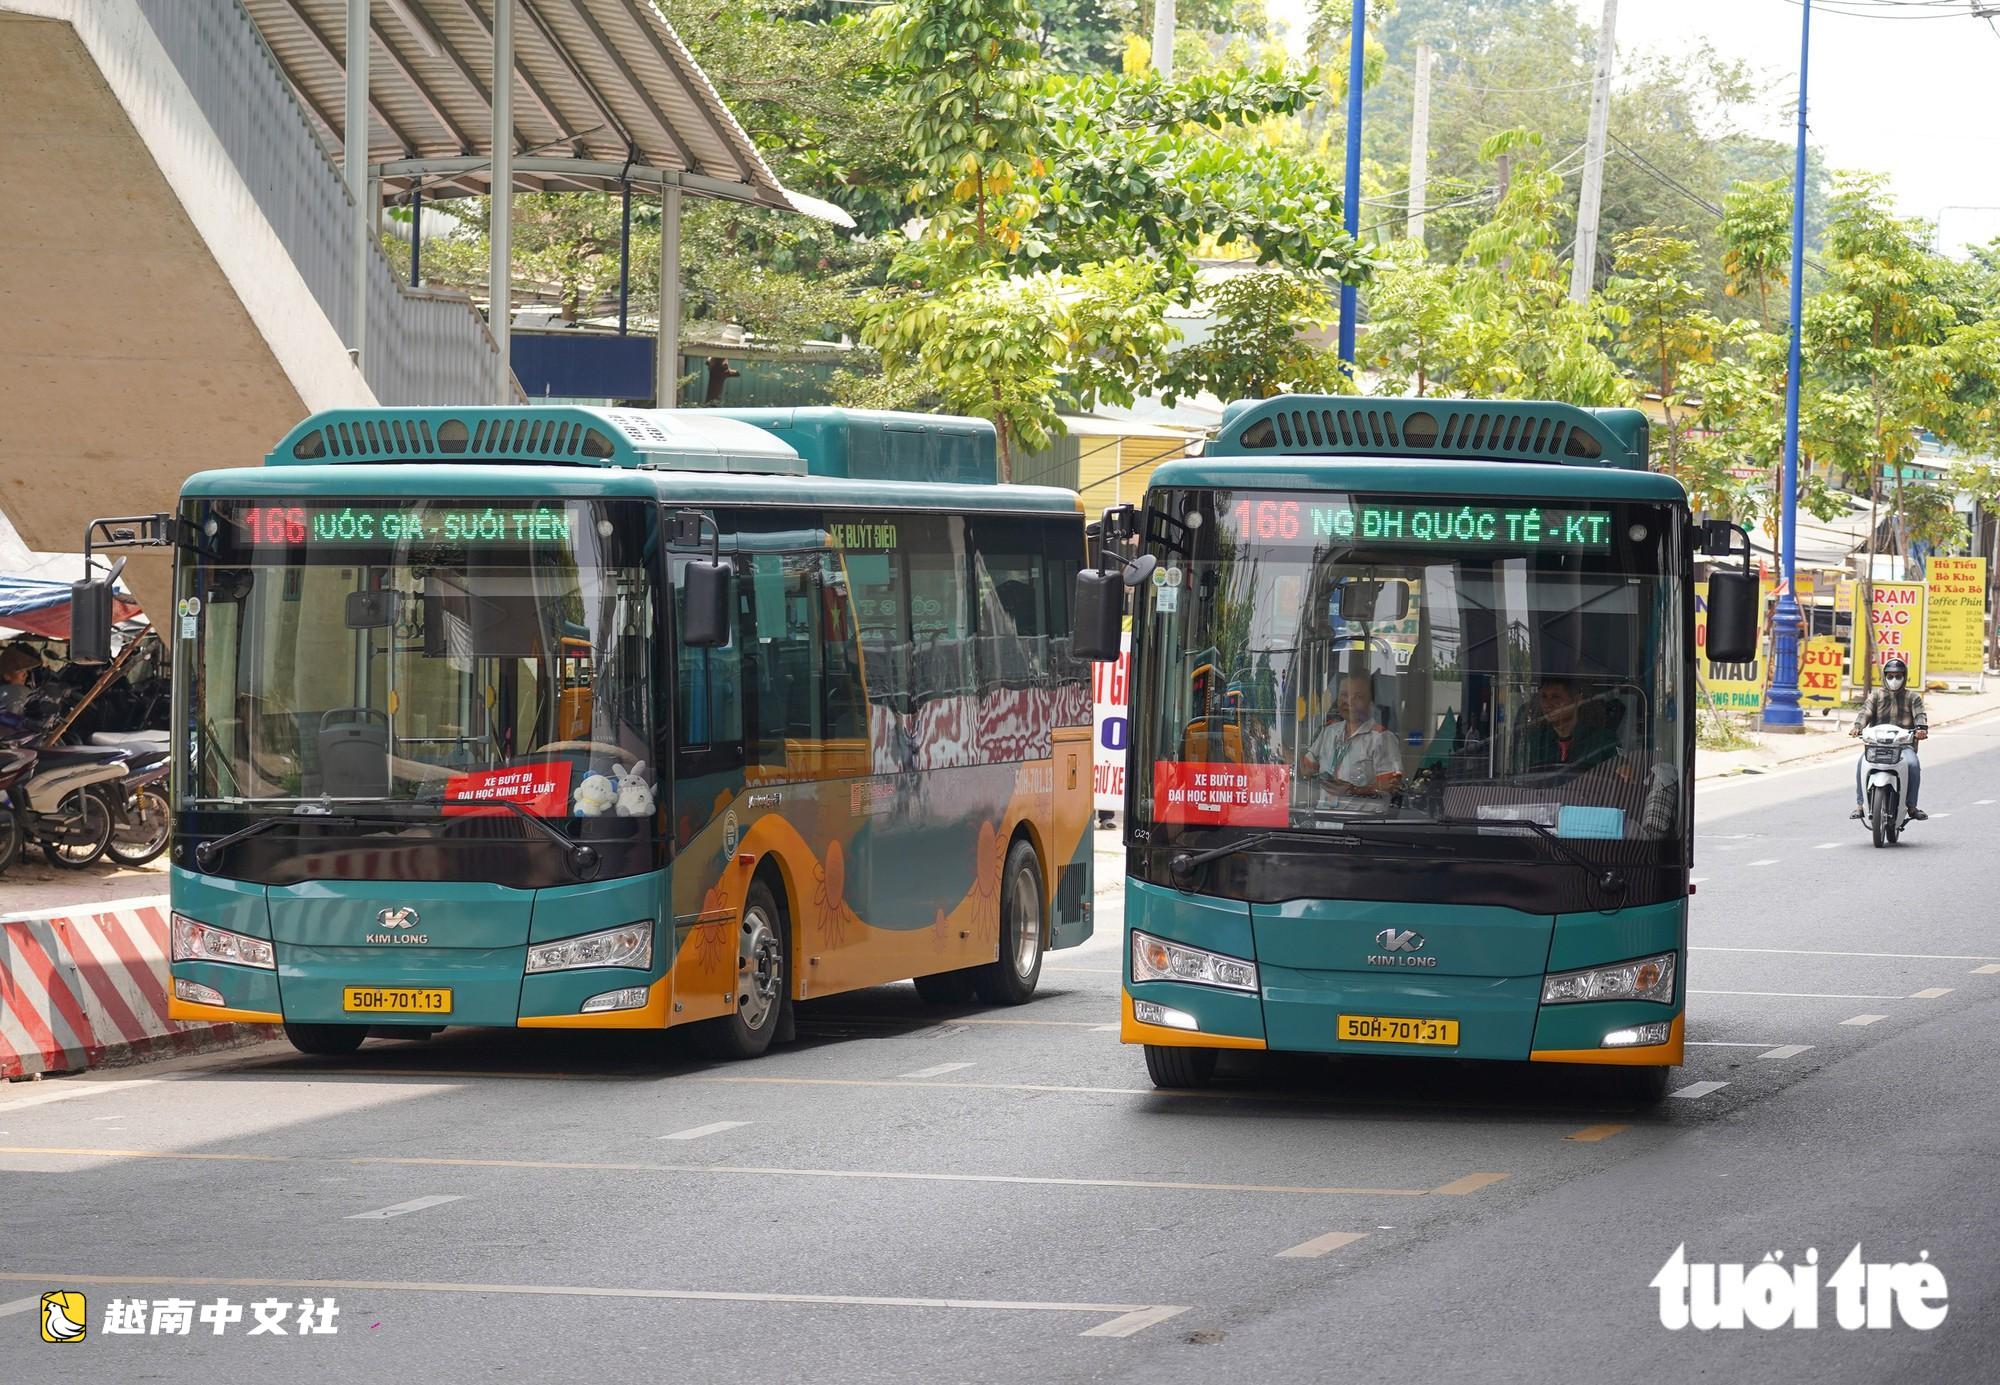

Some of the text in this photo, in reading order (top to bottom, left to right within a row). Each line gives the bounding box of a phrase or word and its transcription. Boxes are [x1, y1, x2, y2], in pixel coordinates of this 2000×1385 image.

[247, 508, 304, 543] 166
[314, 508, 374, 541] UỐC
[382, 514, 424, 540] GIA
[512, 508, 569, 540] TIÊN
[1235, 500, 1299, 539] 166
[1310, 508, 1354, 536] NG
[1362, 510, 1402, 538] ĐH
[1566, 515, 1610, 543] KT
[831, 524, 844, 548] XE
[846, 519, 872, 548] BUÝT
[1953, 573, 1975, 581] Kho
[1872, 589, 1916, 608] RẠM
[1928, 596, 1957, 606] Coffee
[1872, 609, 1909, 628] SẠC
[1878, 631, 1900, 645] XE
[1803, 646, 1842, 666] GỬI
[1803, 672, 1837, 689] XE
[484, 773, 532, 787] XE BUÝT ĐI
[1111, 767, 1124, 795] XE
[1195, 772, 1247, 787] XE BUÝT ĐI
[475, 788, 493, 800] HỌC
[496, 786, 517, 797] KINH
[521, 783, 531, 794] TẾ
[1168, 787, 1273, 806] ĐẠI HỌC KINH TẾ LUẬT
[366, 934, 428, 944] KIM LONG
[1367, 955, 1436, 968] KIM LONG
[353, 992, 442, 1009] 50H-701.13
[1349, 1020, 1447, 1041] 50H-701.31
